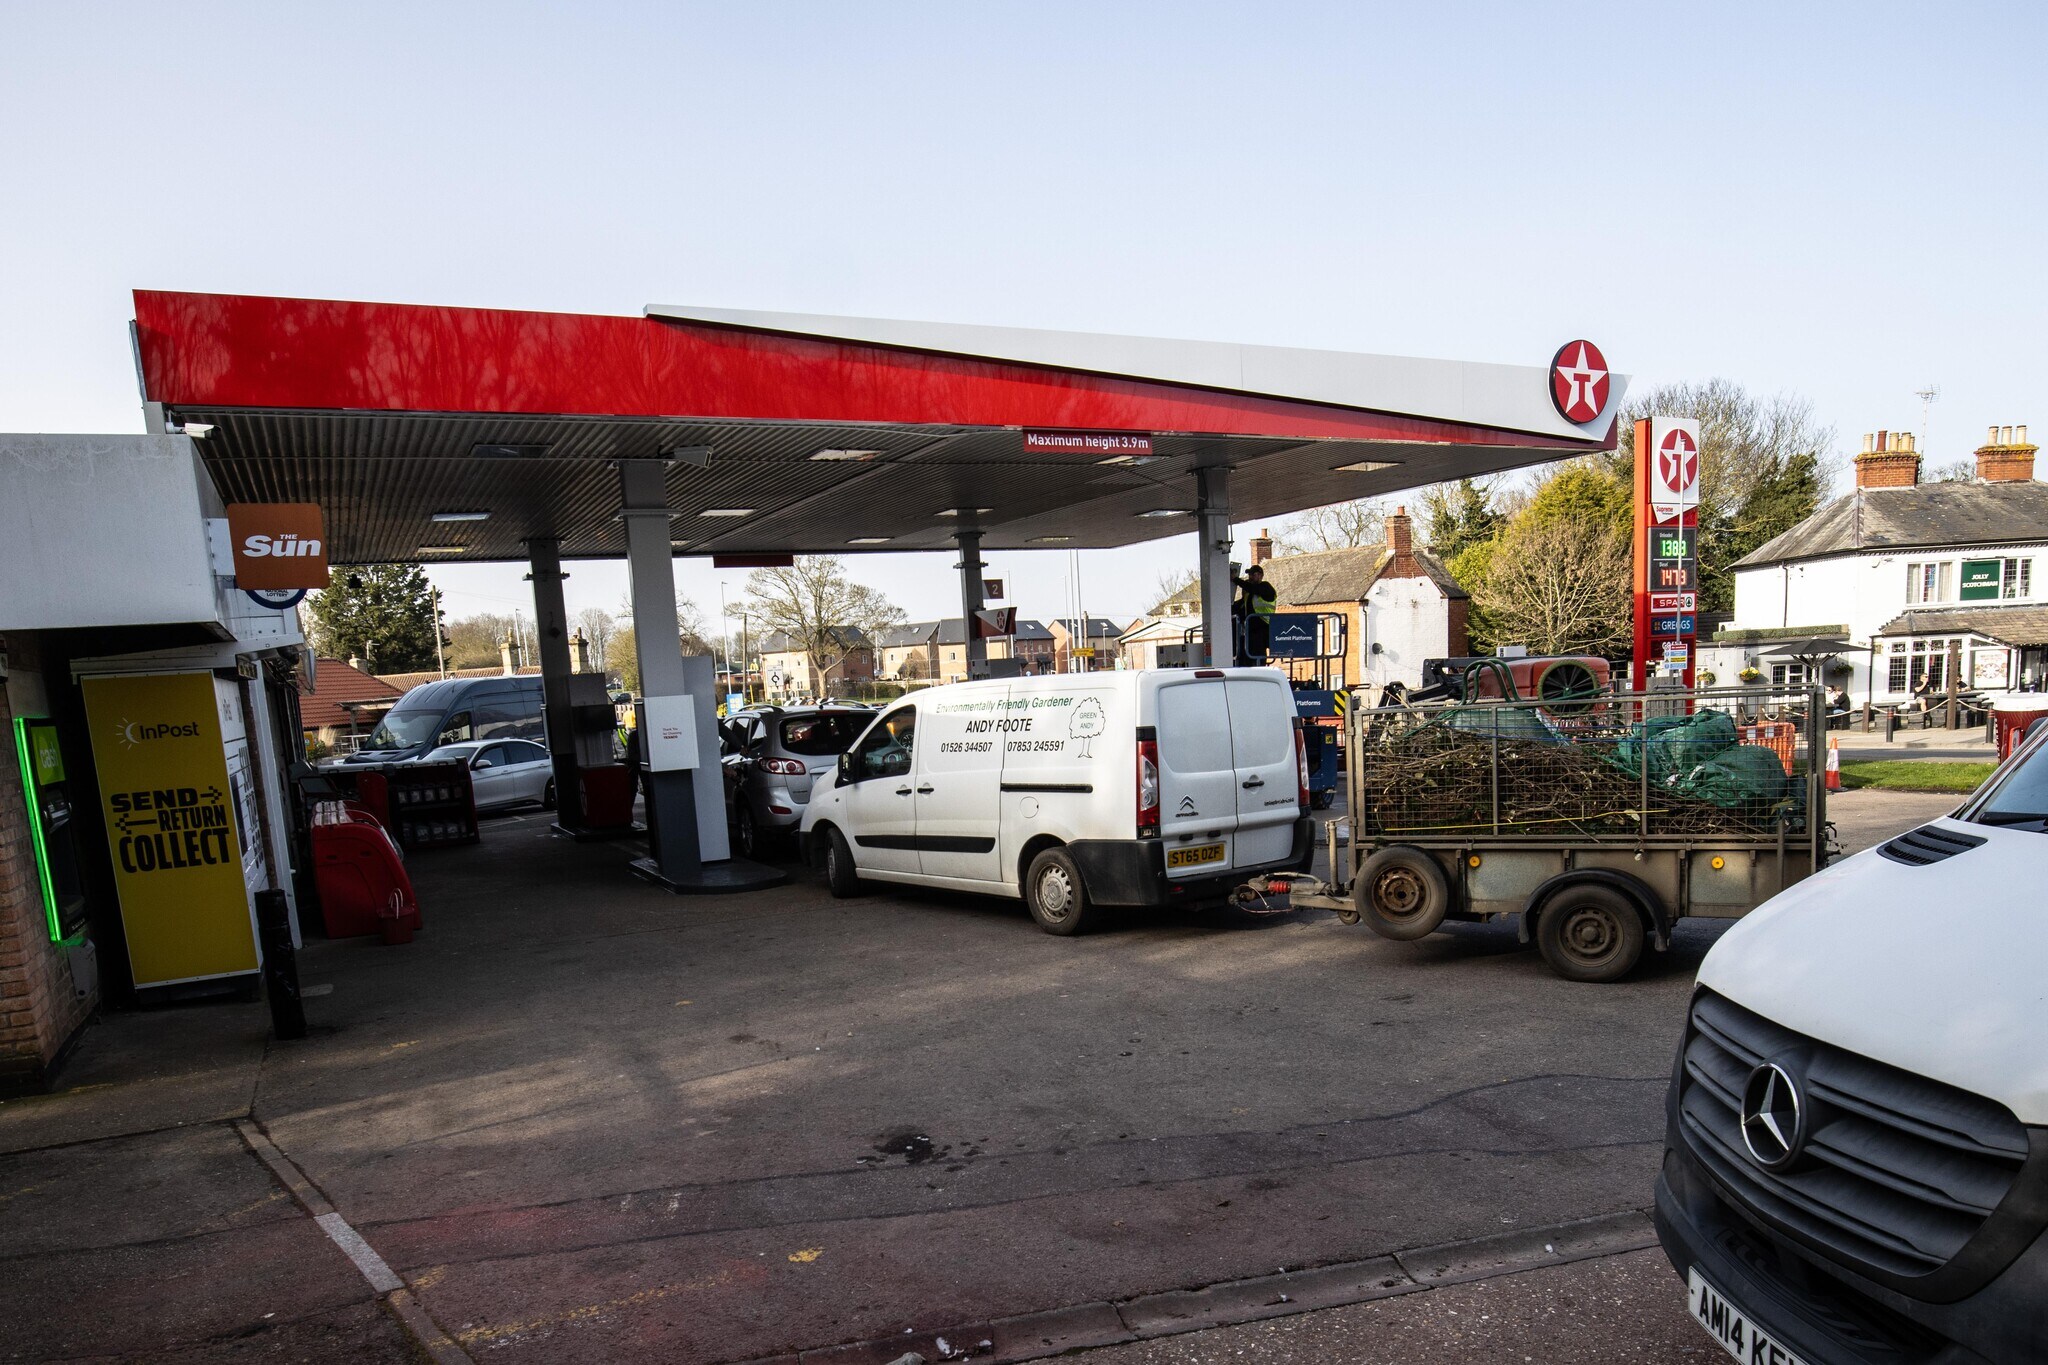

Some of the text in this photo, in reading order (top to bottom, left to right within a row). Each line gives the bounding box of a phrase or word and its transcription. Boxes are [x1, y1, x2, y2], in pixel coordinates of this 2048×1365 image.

[1027, 433, 1149, 450] Maximum height 3.9m
[242, 535, 321, 557] Sun
[992, 583, 999, 595] 2
[936, 696, 1073, 714] Environmentally Friendly Gardener
[139, 721, 200, 740] InPost
[965, 718, 1033, 733] ANDY FOOTE
[940, 740, 1065, 753] 01526 344507 07853 245591
[110, 788, 199, 813] SEND
[157, 804, 228, 832] RETURN
[118, 827, 230, 874] COLLECT
[1172, 846, 1221, 865] ST65 OZF
[1699, 1285, 1795, 1365] AM14 KE
